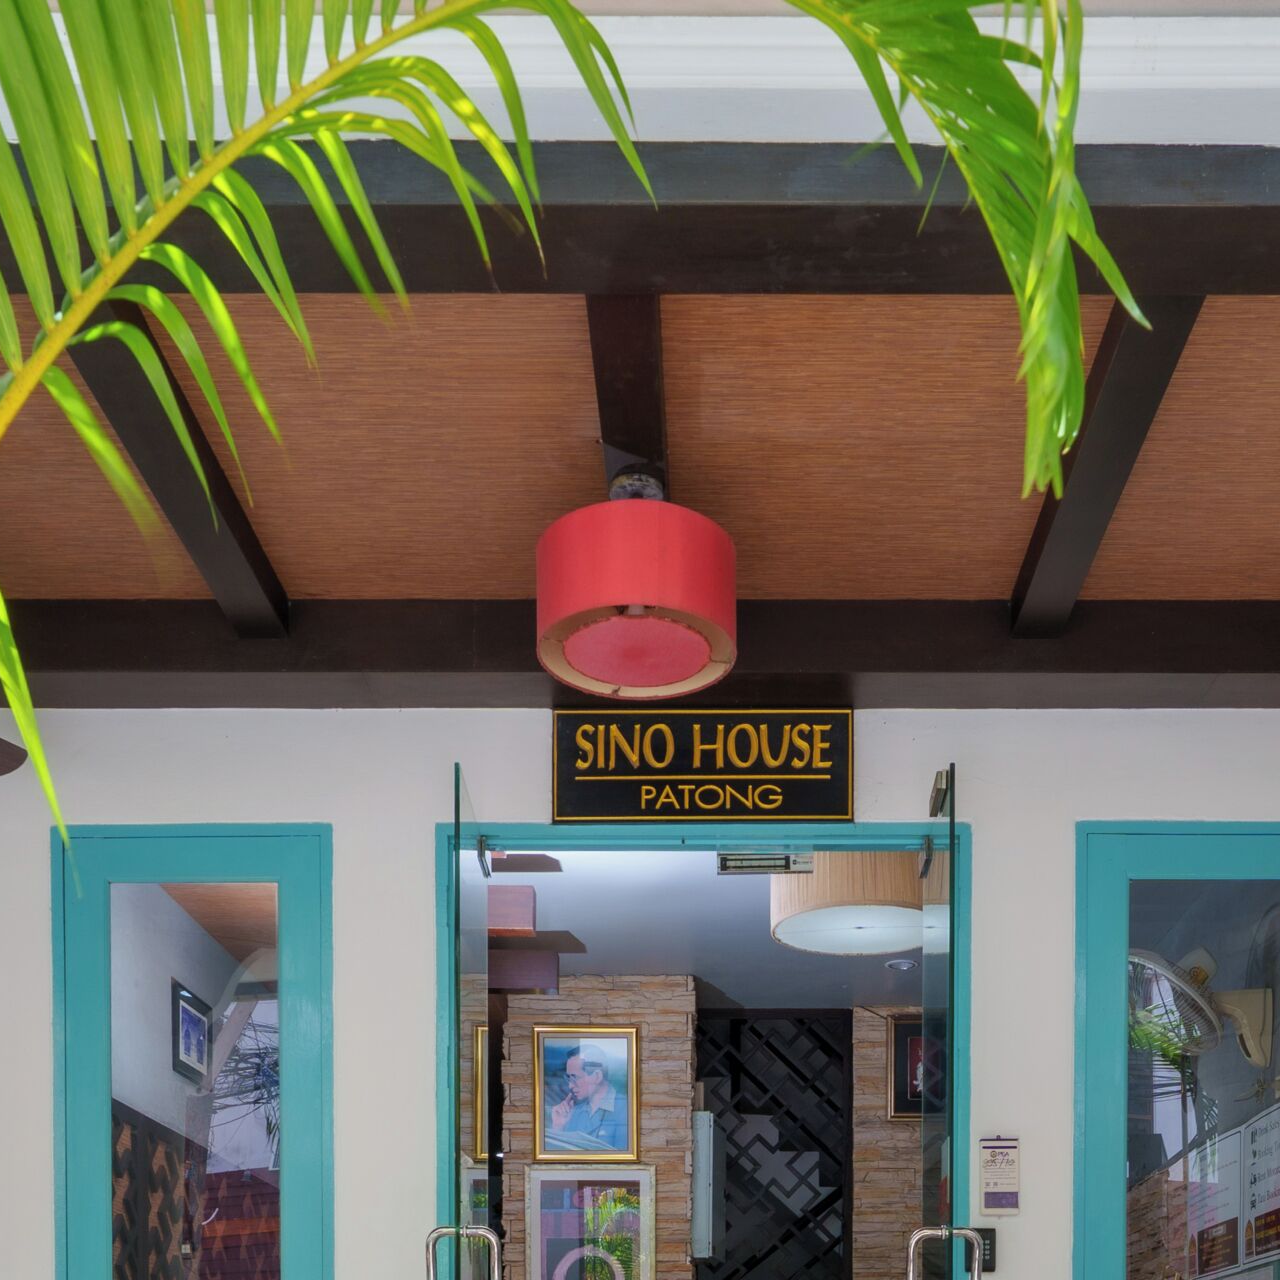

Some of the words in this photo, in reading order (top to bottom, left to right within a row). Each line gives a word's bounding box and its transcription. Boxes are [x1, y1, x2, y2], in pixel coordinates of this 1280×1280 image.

[575, 723, 675, 770] SINO
[692, 723, 833, 769] HOUSE
[640, 784, 783, 810] PATONG
